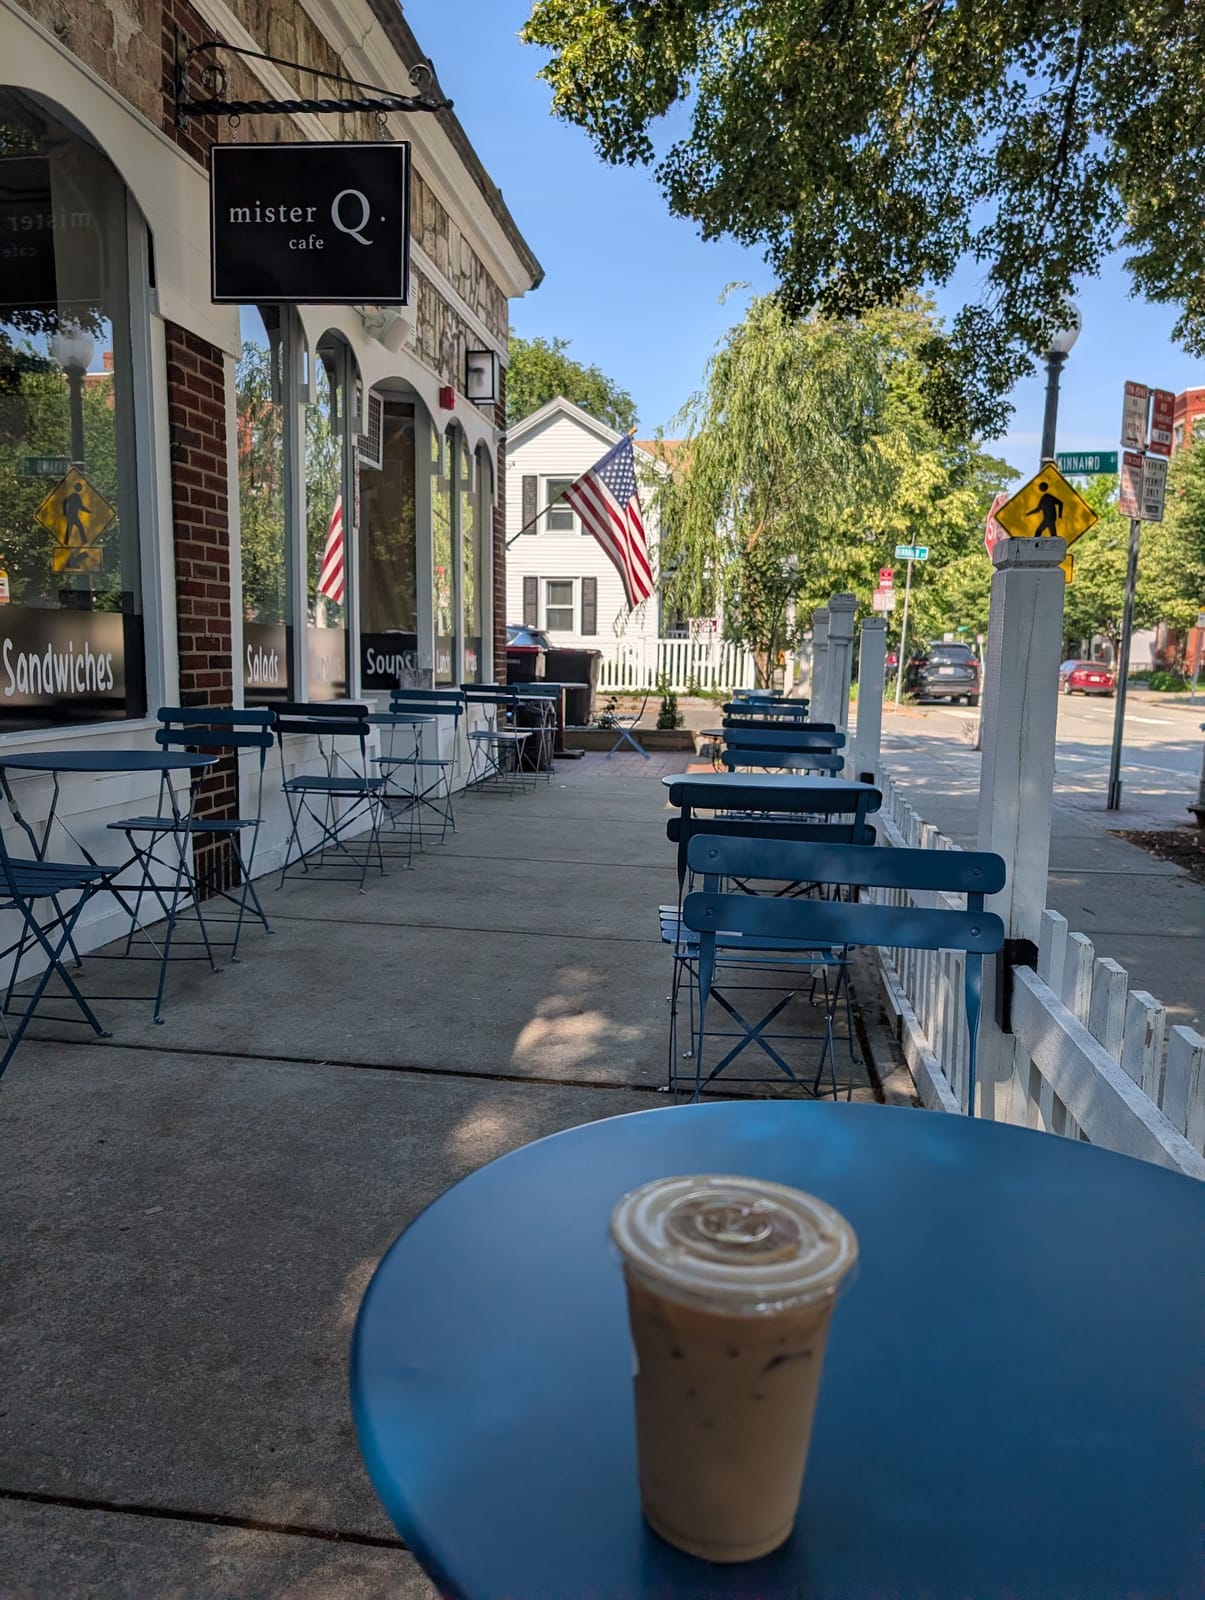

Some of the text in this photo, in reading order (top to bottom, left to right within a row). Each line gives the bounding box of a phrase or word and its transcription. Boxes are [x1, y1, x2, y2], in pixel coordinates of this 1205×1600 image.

[229, 200, 317, 223] mister
[289, 233, 325, 250] cafe
[1057, 455, 1101, 472] KINNAIRD
[1145, 476, 1163, 487] PERMIT
[3, 638, 114, 697] Sandwiches
[247, 643, 279, 684] Salads
